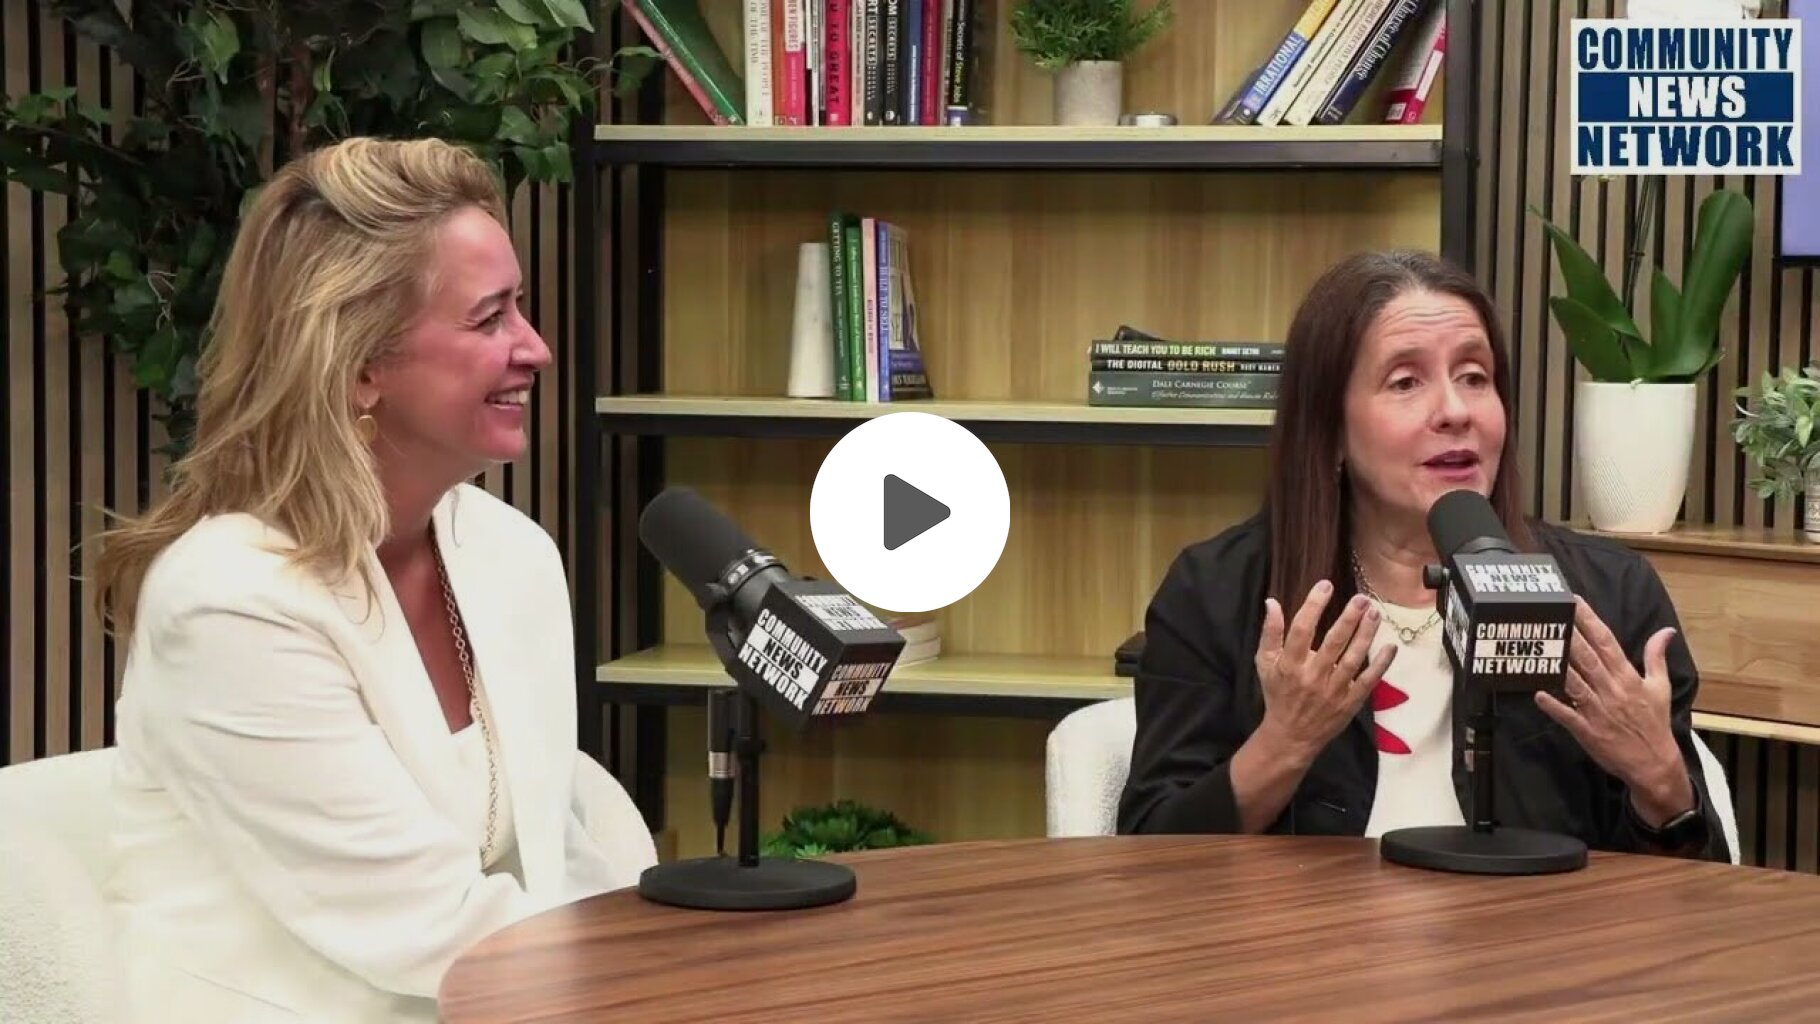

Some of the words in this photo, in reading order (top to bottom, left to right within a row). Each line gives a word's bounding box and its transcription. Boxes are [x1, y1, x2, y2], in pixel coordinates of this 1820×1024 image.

[956, 22, 966, 51] Secrets
[956, 51, 964, 60] of
[955, 61, 964, 82] Steve
[1253, 34, 1302, 96] IRRATIONAL
[830, 51, 840, 103] GREAT
[1101, 344, 1121, 353] WILL
[1122, 344, 1149, 354] TEACH
[1151, 345, 1168, 354] YOU
[1169, 345, 1180, 354] TO
[1181, 345, 1193, 355] BE
[1194, 346, 1216, 355] RICH
[1107, 360, 1125, 369] THE
[1127, 360, 1163, 370] DIGITAL
[1168, 360, 1198, 371] GOLD
[1202, 361, 1235, 372] RUSH
[1491, 574, 1540, 582] NEWS
[1475, 582, 1565, 592] NETWORK
[1476, 623, 1567, 639] COMMUNITY
[757, 608, 828, 674] COMMUNITY
[1495, 641, 1545, 656] NEWS
[763, 638, 803, 679] NEWS
[1473, 659, 1562, 674] NETWORK
[738, 642, 809, 711] NETWORK
[831, 663, 893, 680] COMMUNITY
[834, 681, 871, 696] NEWS
[811, 697, 871, 715] NETWORK
